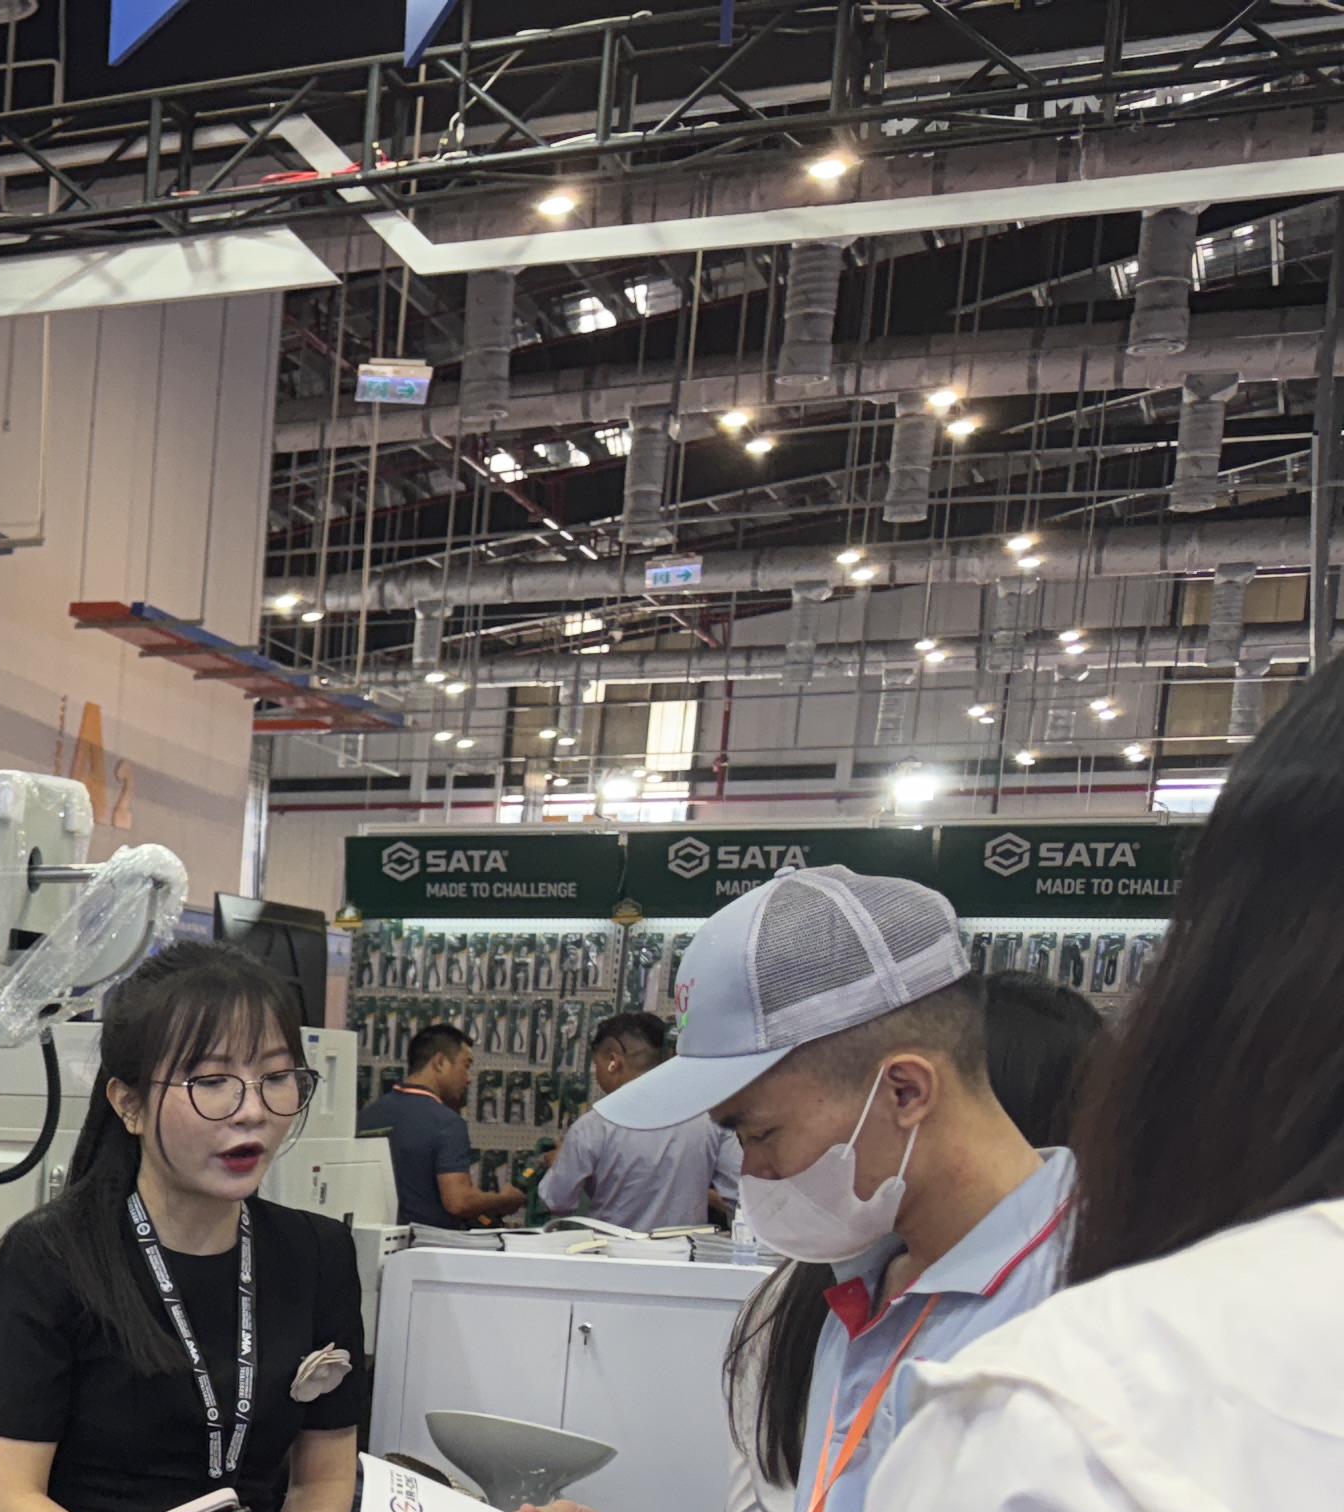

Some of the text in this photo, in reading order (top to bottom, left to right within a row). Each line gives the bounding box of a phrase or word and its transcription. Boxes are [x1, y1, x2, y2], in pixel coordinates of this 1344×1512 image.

[426, 850, 508, 872] SATA
[716, 846, 808, 869] SATA
[1038, 842, 1138, 867] SATA
[426, 882, 577, 898] MADE TO CHALLENGE
[1036, 878, 1085, 895] MADE
[1091, 878, 1114, 895] TO
